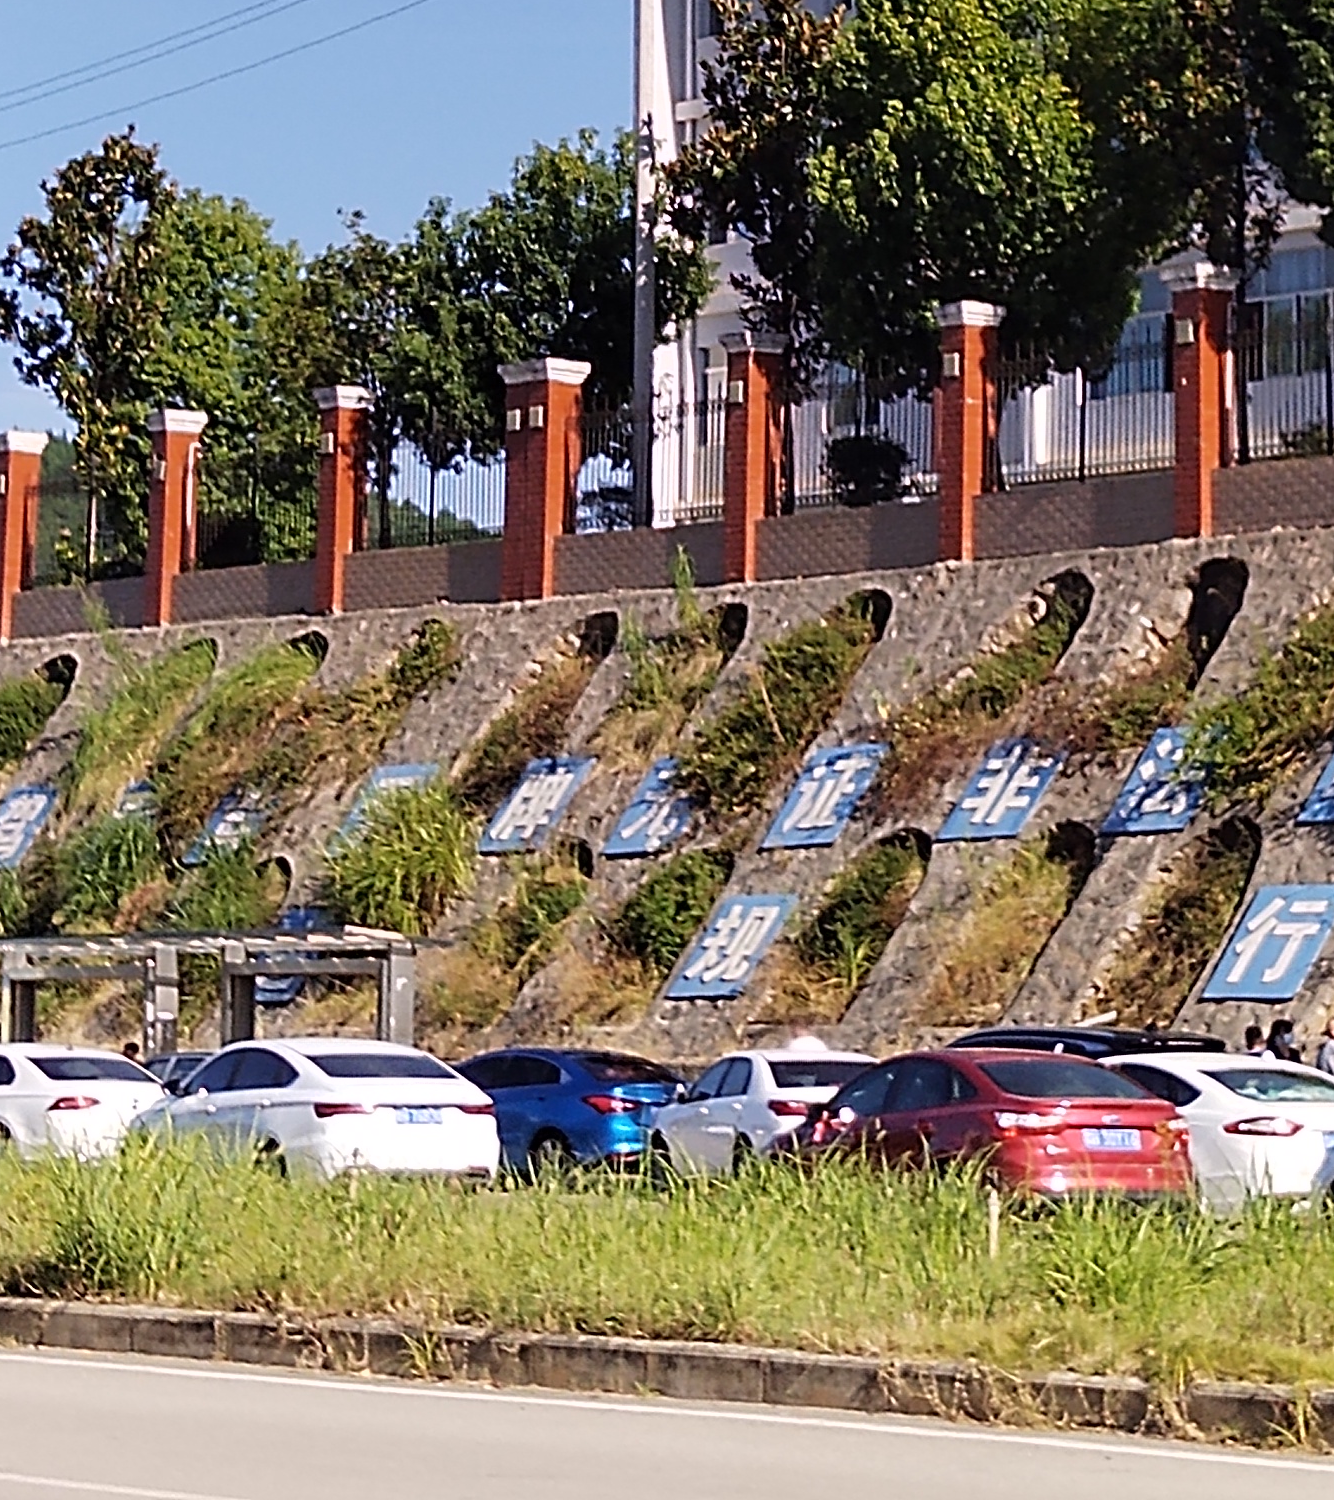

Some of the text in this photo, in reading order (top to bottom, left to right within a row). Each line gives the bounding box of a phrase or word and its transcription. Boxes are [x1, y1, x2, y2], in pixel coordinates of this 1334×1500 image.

[781, 757, 870, 834] 证
[961, 745, 1055, 825] 非
[682, 904, 780, 983] 规
[1226, 897, 1327, 984] 行
